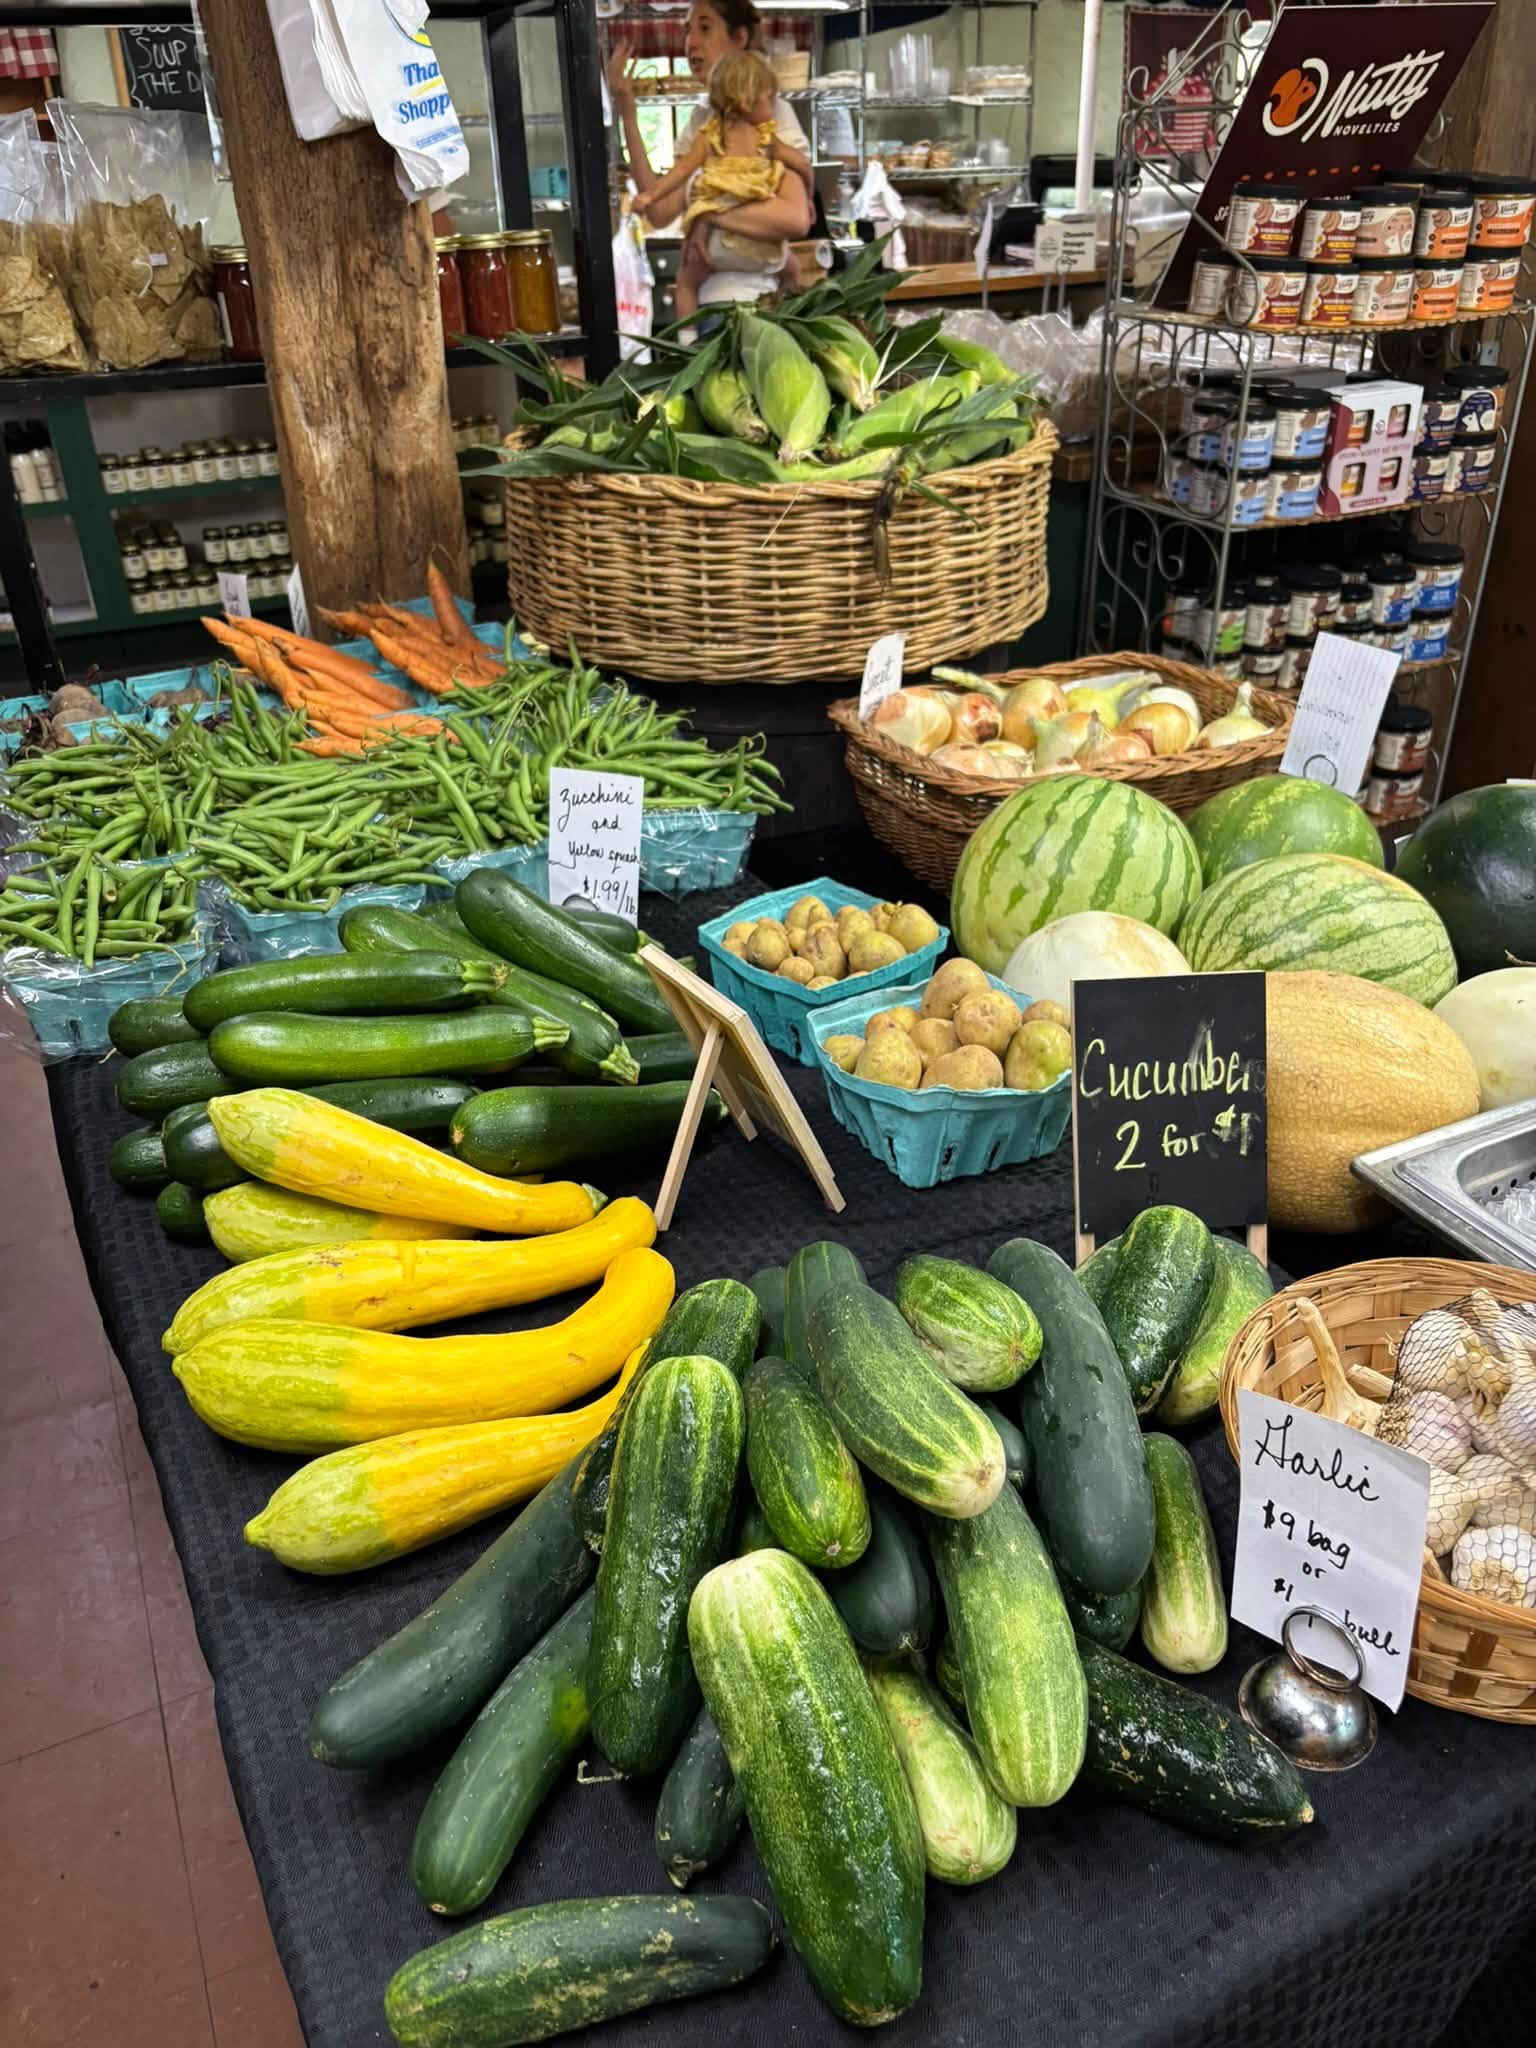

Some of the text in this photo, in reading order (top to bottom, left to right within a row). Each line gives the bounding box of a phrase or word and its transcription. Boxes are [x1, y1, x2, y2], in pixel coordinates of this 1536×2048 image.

[137, 71, 183, 97] THE
[404, 62, 440, 86] Tha
[399, 93, 450, 124] Shopp
[1301, 49, 1445, 143] Nutty
[1333, 122, 1401, 136] NOVELTIES
[1114, 1120, 1146, 1172] 2
[1161, 1123, 1207, 1158] for
[1255, 1414, 1380, 1502] Garlic
[1263, 1499, 1351, 1570] $9 bag
[1302, 1561, 1328, 1579] or
